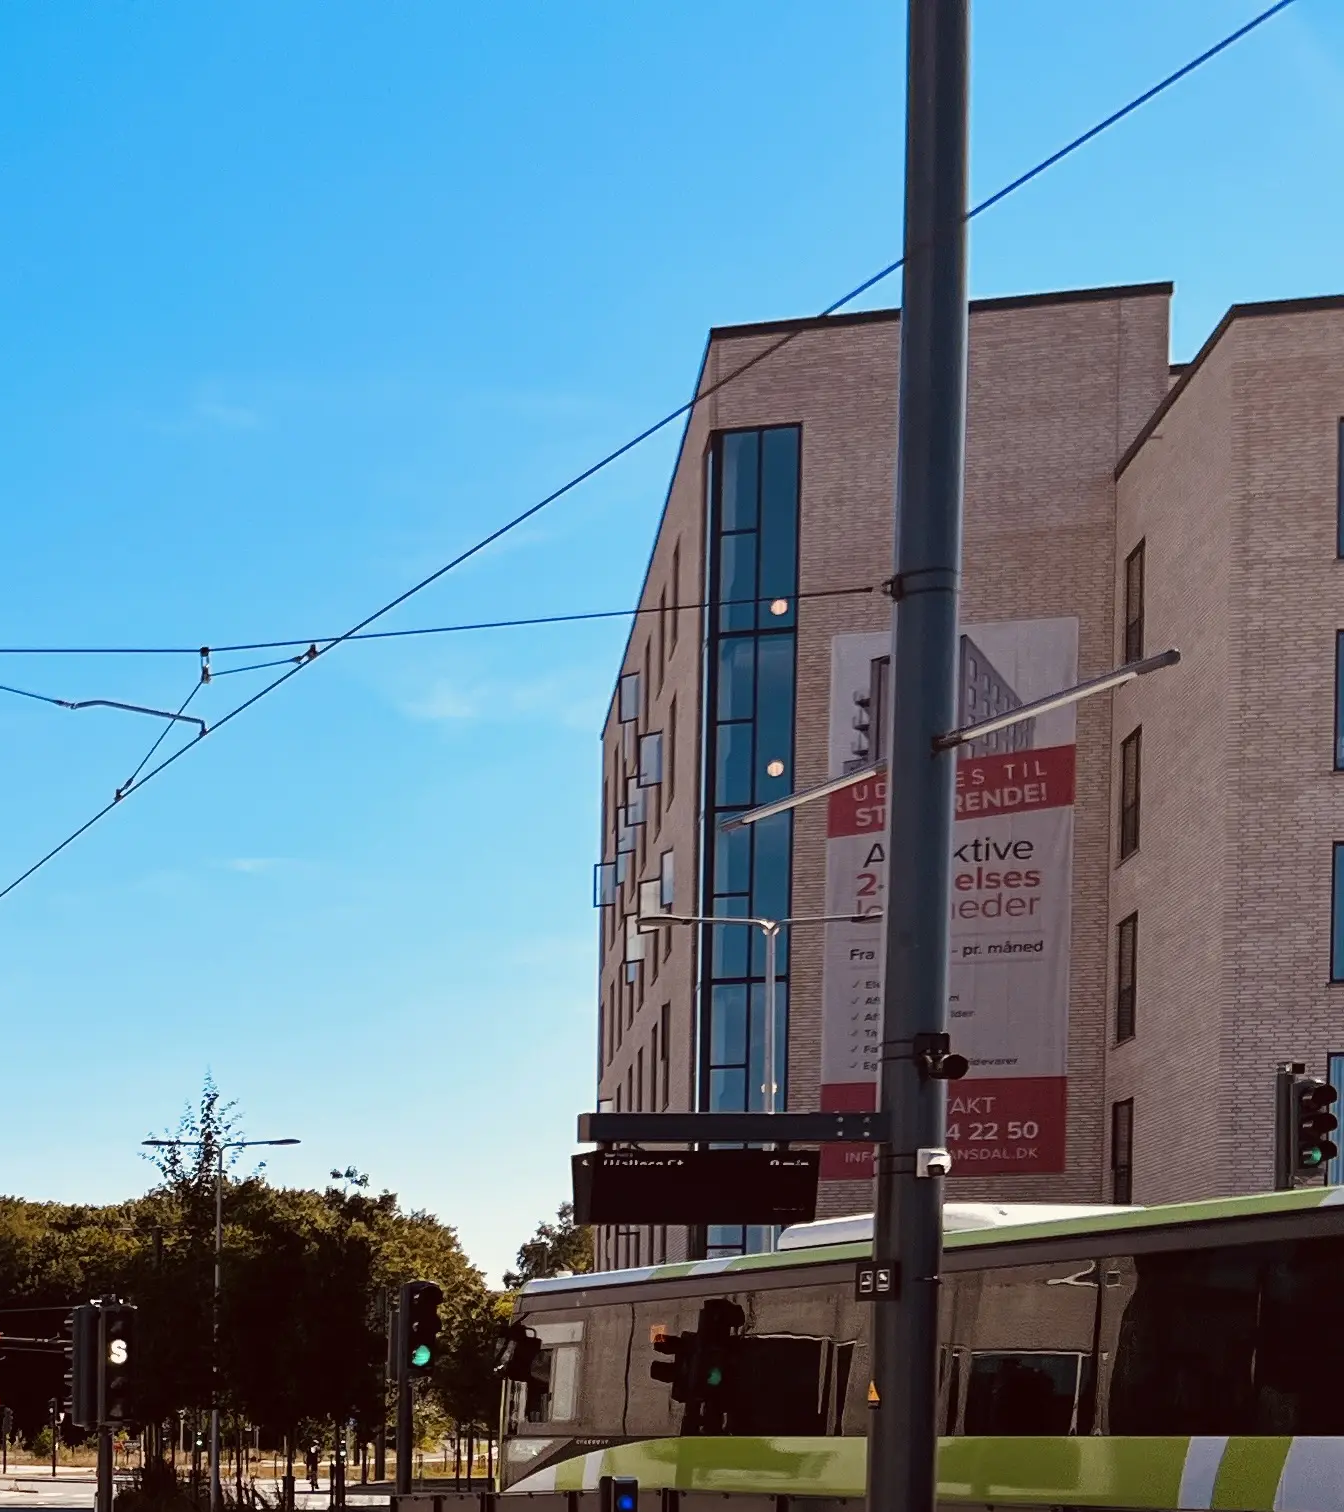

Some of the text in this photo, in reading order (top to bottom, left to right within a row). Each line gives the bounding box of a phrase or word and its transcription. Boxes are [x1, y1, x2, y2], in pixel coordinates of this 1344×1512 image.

[1004, 760, 1048, 780] TIL
[850, 940, 1044, 960] Fra pr. måned
[969, 1123, 999, 1140] 22
[1008, 1121, 1039, 1139] 50
